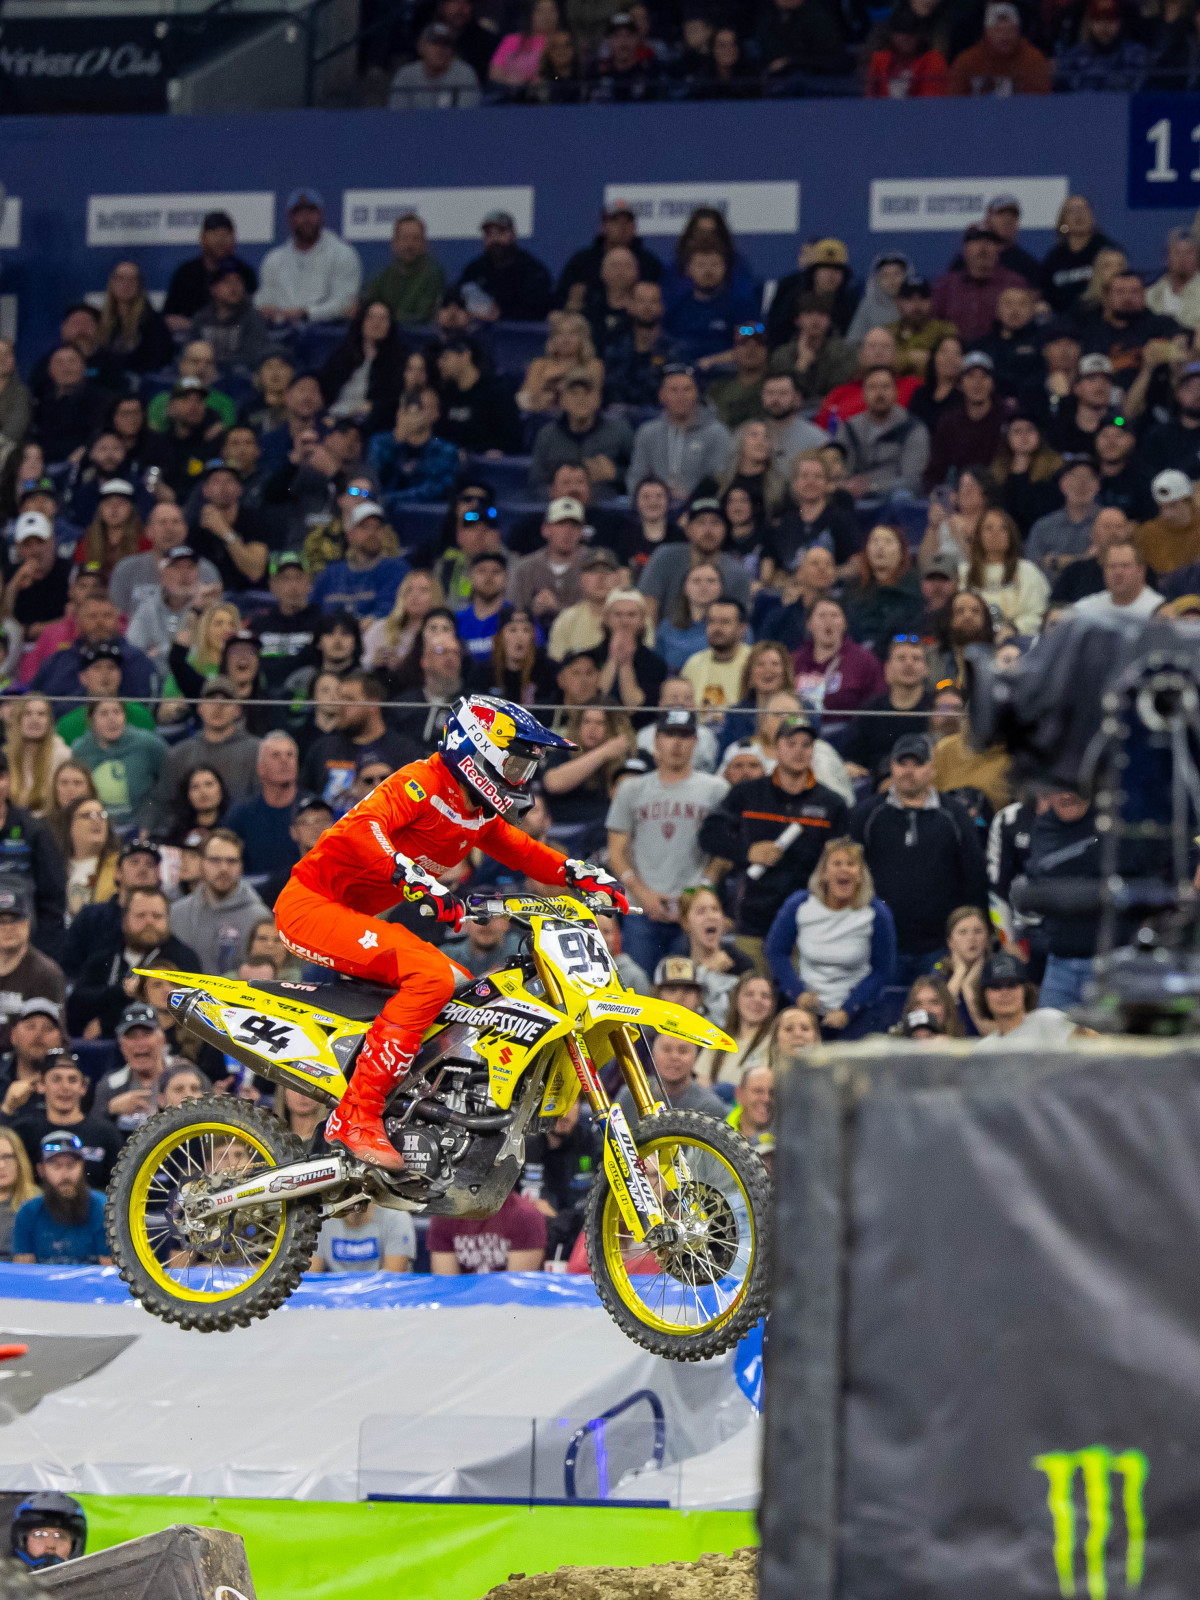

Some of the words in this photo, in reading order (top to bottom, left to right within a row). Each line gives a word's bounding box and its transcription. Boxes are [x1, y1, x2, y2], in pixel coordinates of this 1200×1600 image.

[467, 724, 492, 752] FOX
[409, 779, 425, 800] WD-40
[278, 930, 335, 967] SUZUKI
[557, 931, 610, 975] 94
[198, 979, 239, 990] DUNLOP
[280, 982, 317, 992] GUTS
[441, 1002, 543, 1041] PROGRESSIVE
[596, 1002, 642, 1016] PROGRESSIVE
[233, 1015, 295, 1054] 94
[493, 1065, 513, 1076] SUZUKI
[620, 1131, 658, 1209] DUNLOP
